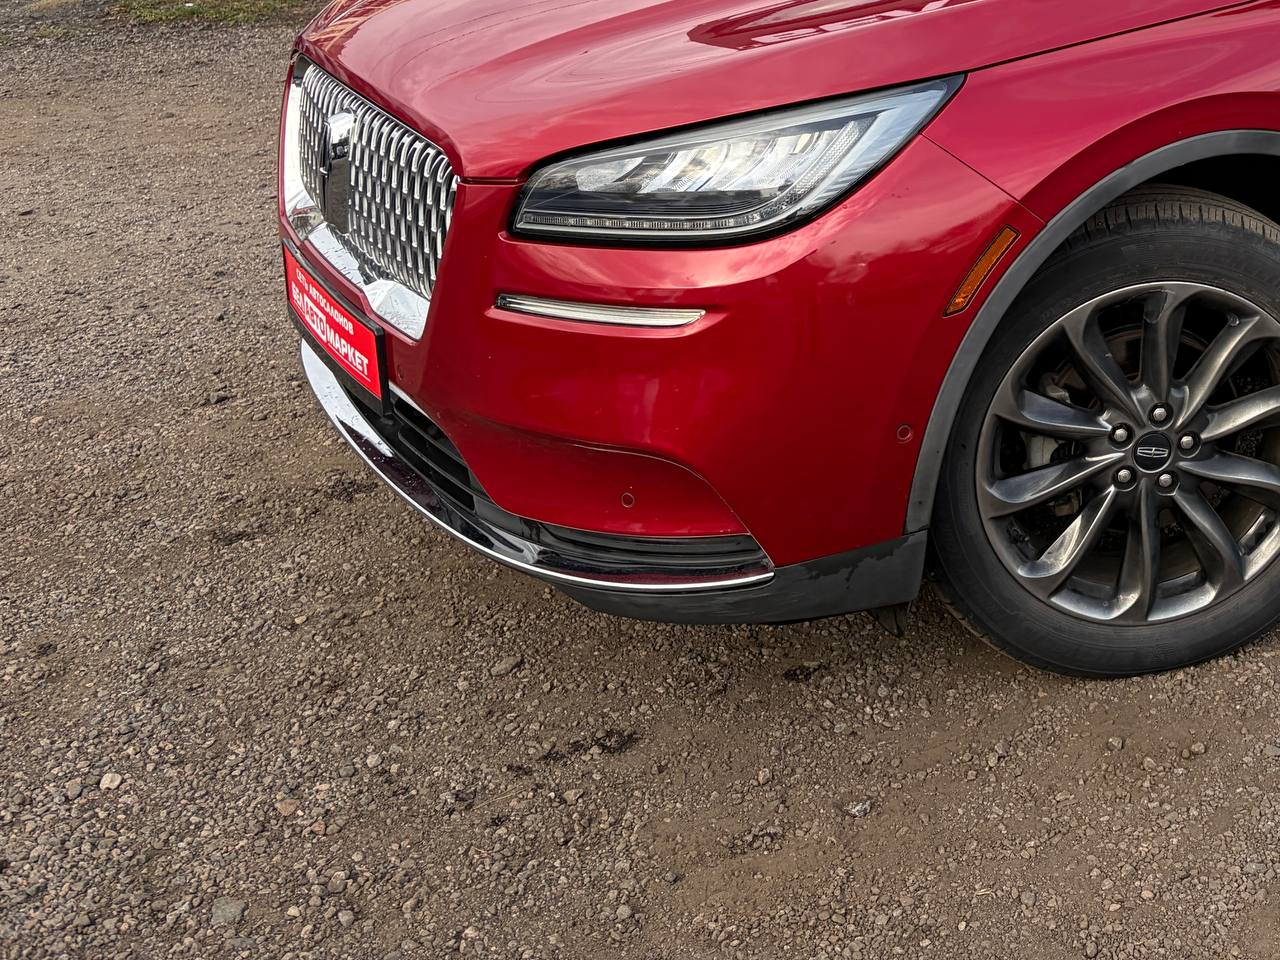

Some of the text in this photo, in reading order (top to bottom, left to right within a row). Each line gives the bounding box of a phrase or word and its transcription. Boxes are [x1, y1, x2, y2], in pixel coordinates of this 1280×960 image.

[292, 280, 369, 375] БЕЛ АВТО МАРКЕТ
[296, 268, 354, 335] СЕТЬ АВТОСАЛОНОВ
